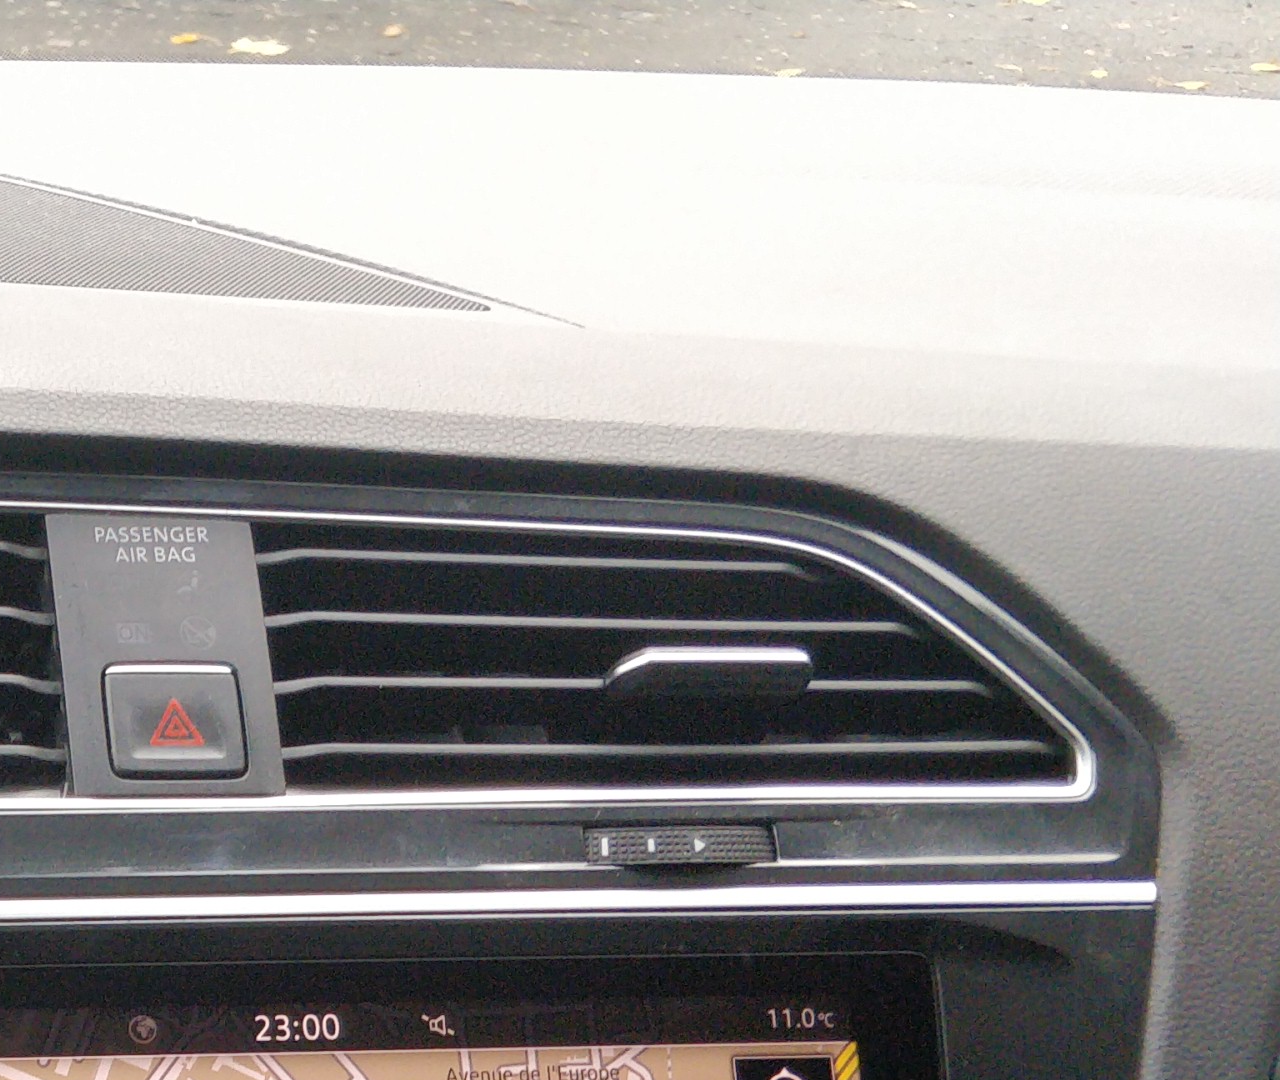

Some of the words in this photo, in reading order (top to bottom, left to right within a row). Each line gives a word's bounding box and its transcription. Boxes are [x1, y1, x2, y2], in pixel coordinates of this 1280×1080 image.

[94, 526, 209, 543] PASSENGER
[115, 547, 148, 563] AIR
[154, 547, 196, 563] BAG
[254, 1013, 340, 1042] 23:00
